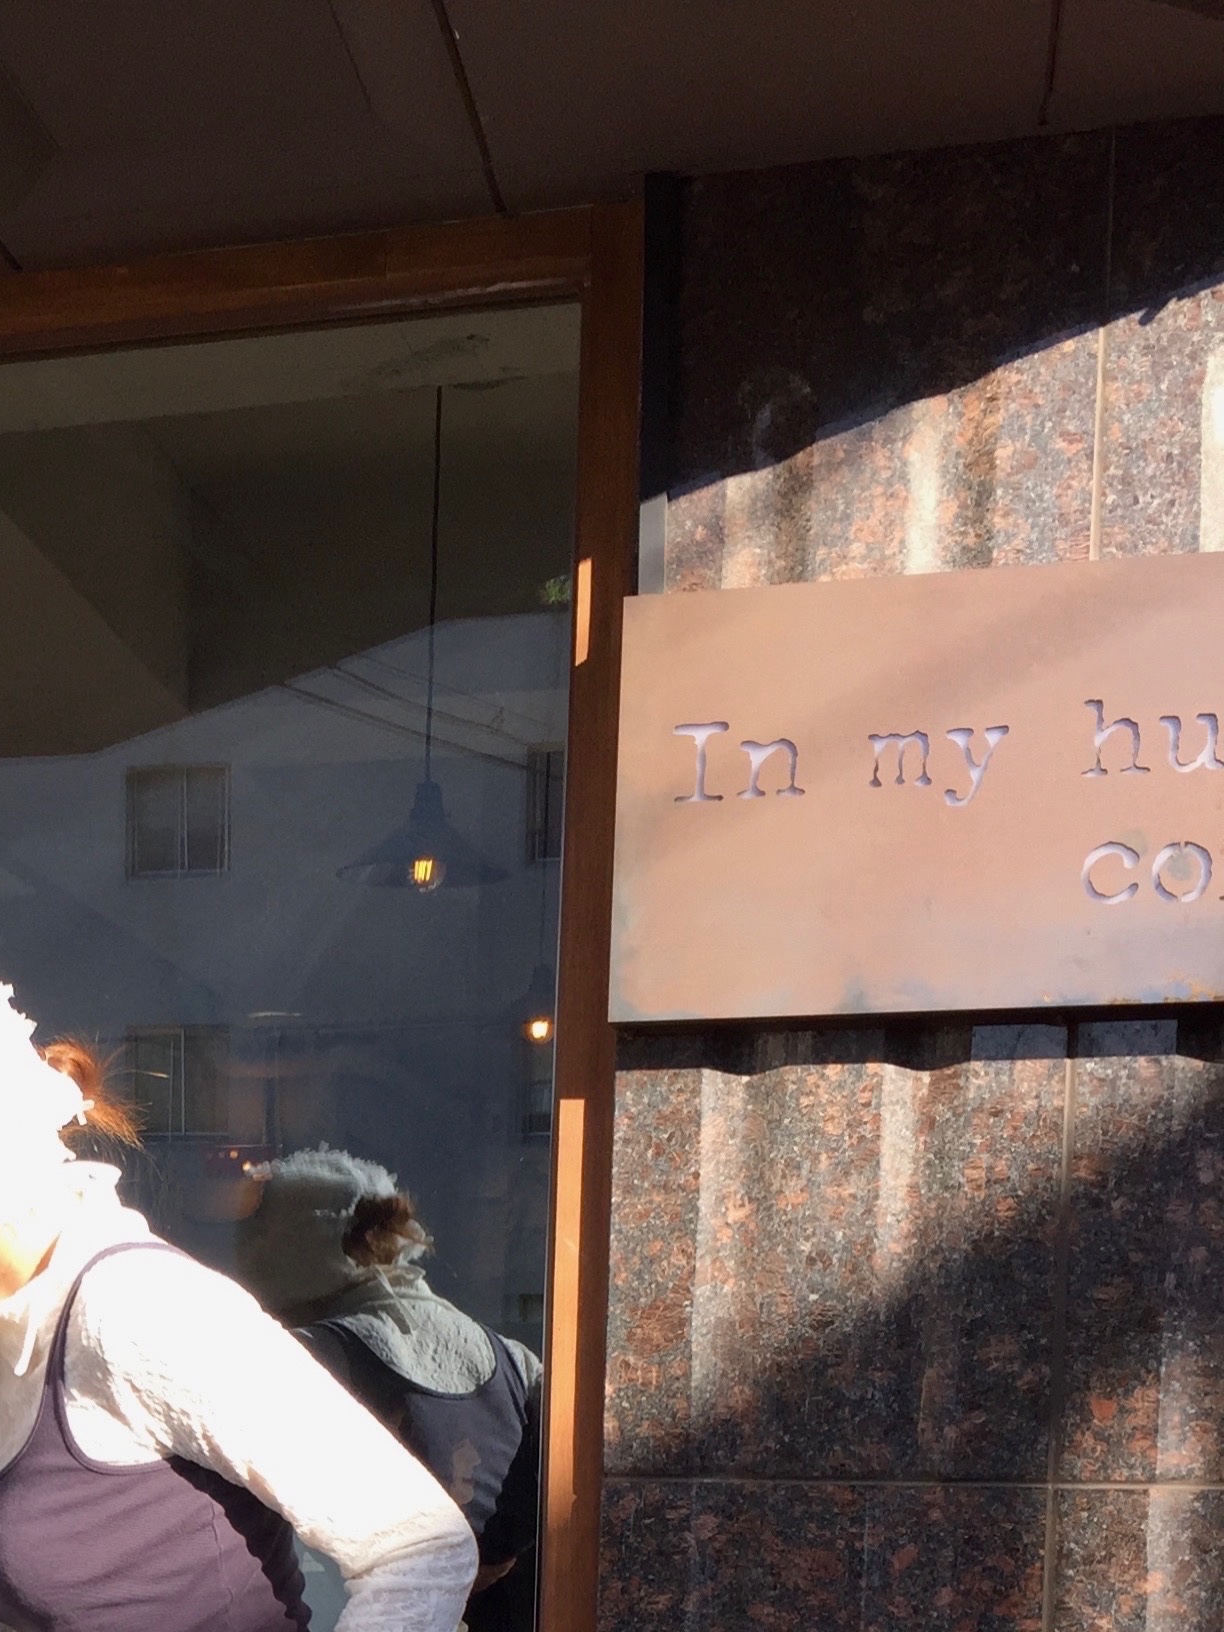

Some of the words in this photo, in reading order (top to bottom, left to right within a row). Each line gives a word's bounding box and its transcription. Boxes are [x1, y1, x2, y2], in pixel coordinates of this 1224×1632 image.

[673, 721, 805, 802] In
[868, 725, 1010, 806] my
[1080, 699, 1224, 776] hu
[1081, 841, 1224, 904] co
